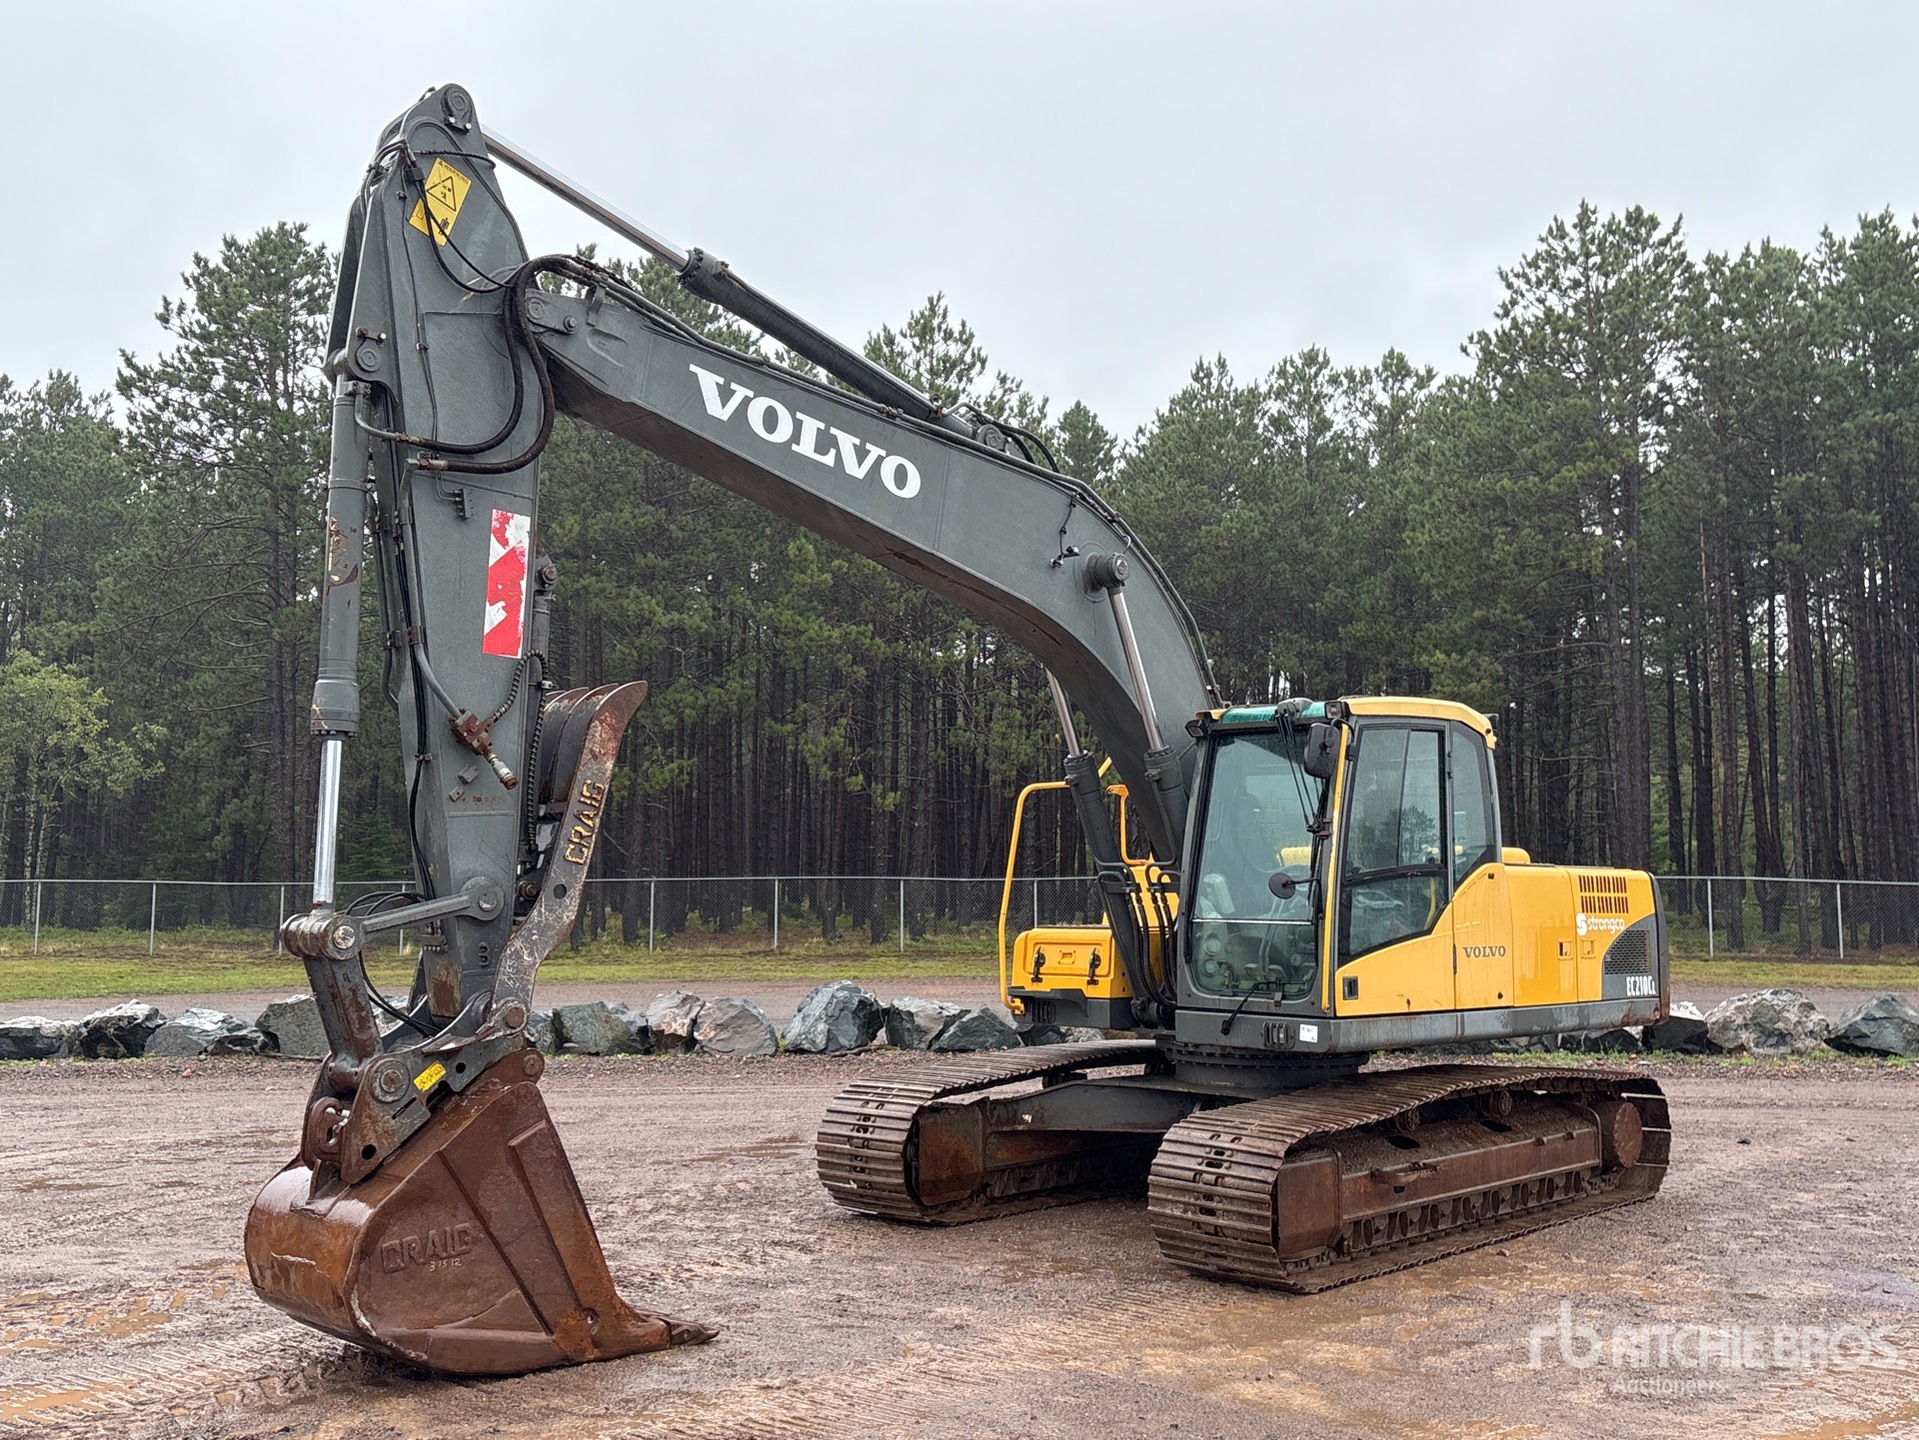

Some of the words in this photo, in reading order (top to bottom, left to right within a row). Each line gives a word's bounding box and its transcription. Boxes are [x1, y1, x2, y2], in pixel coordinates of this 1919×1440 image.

[444, 164, 469, 185] WARNING
[689, 363, 921, 499] VOLVO
[564, 779, 606, 865] CRAIG
[1462, 945, 1507, 958] VOLVO
[381, 1222, 473, 1275] CRAIG
